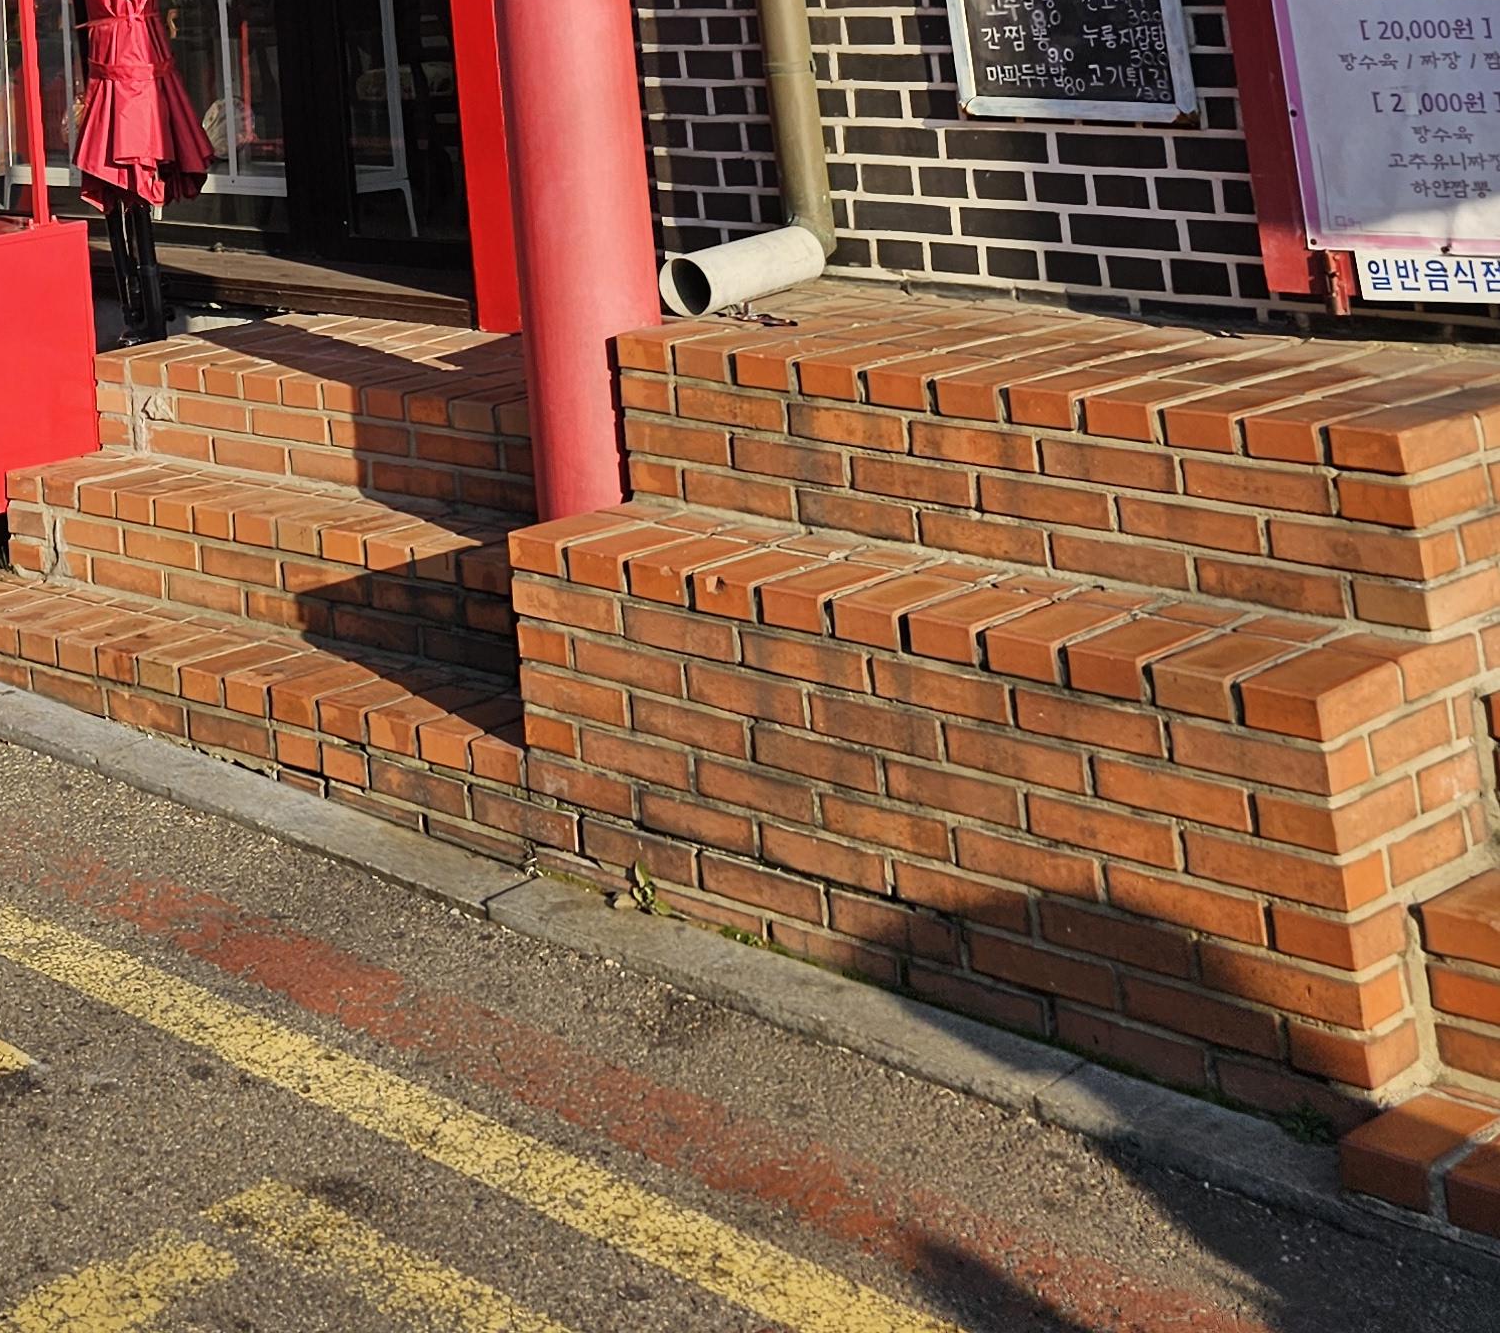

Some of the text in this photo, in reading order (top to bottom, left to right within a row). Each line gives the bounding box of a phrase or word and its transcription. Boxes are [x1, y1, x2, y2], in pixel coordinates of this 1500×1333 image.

[1378, 17, 1475, 42] 20,000원
[1338, 51, 1399, 71] 탕수육
[1420, 51, 1462, 70] 짜장
[1390, 91, 1487, 115] 2,000원
[1411, 125, 1474, 144] 탕수육
